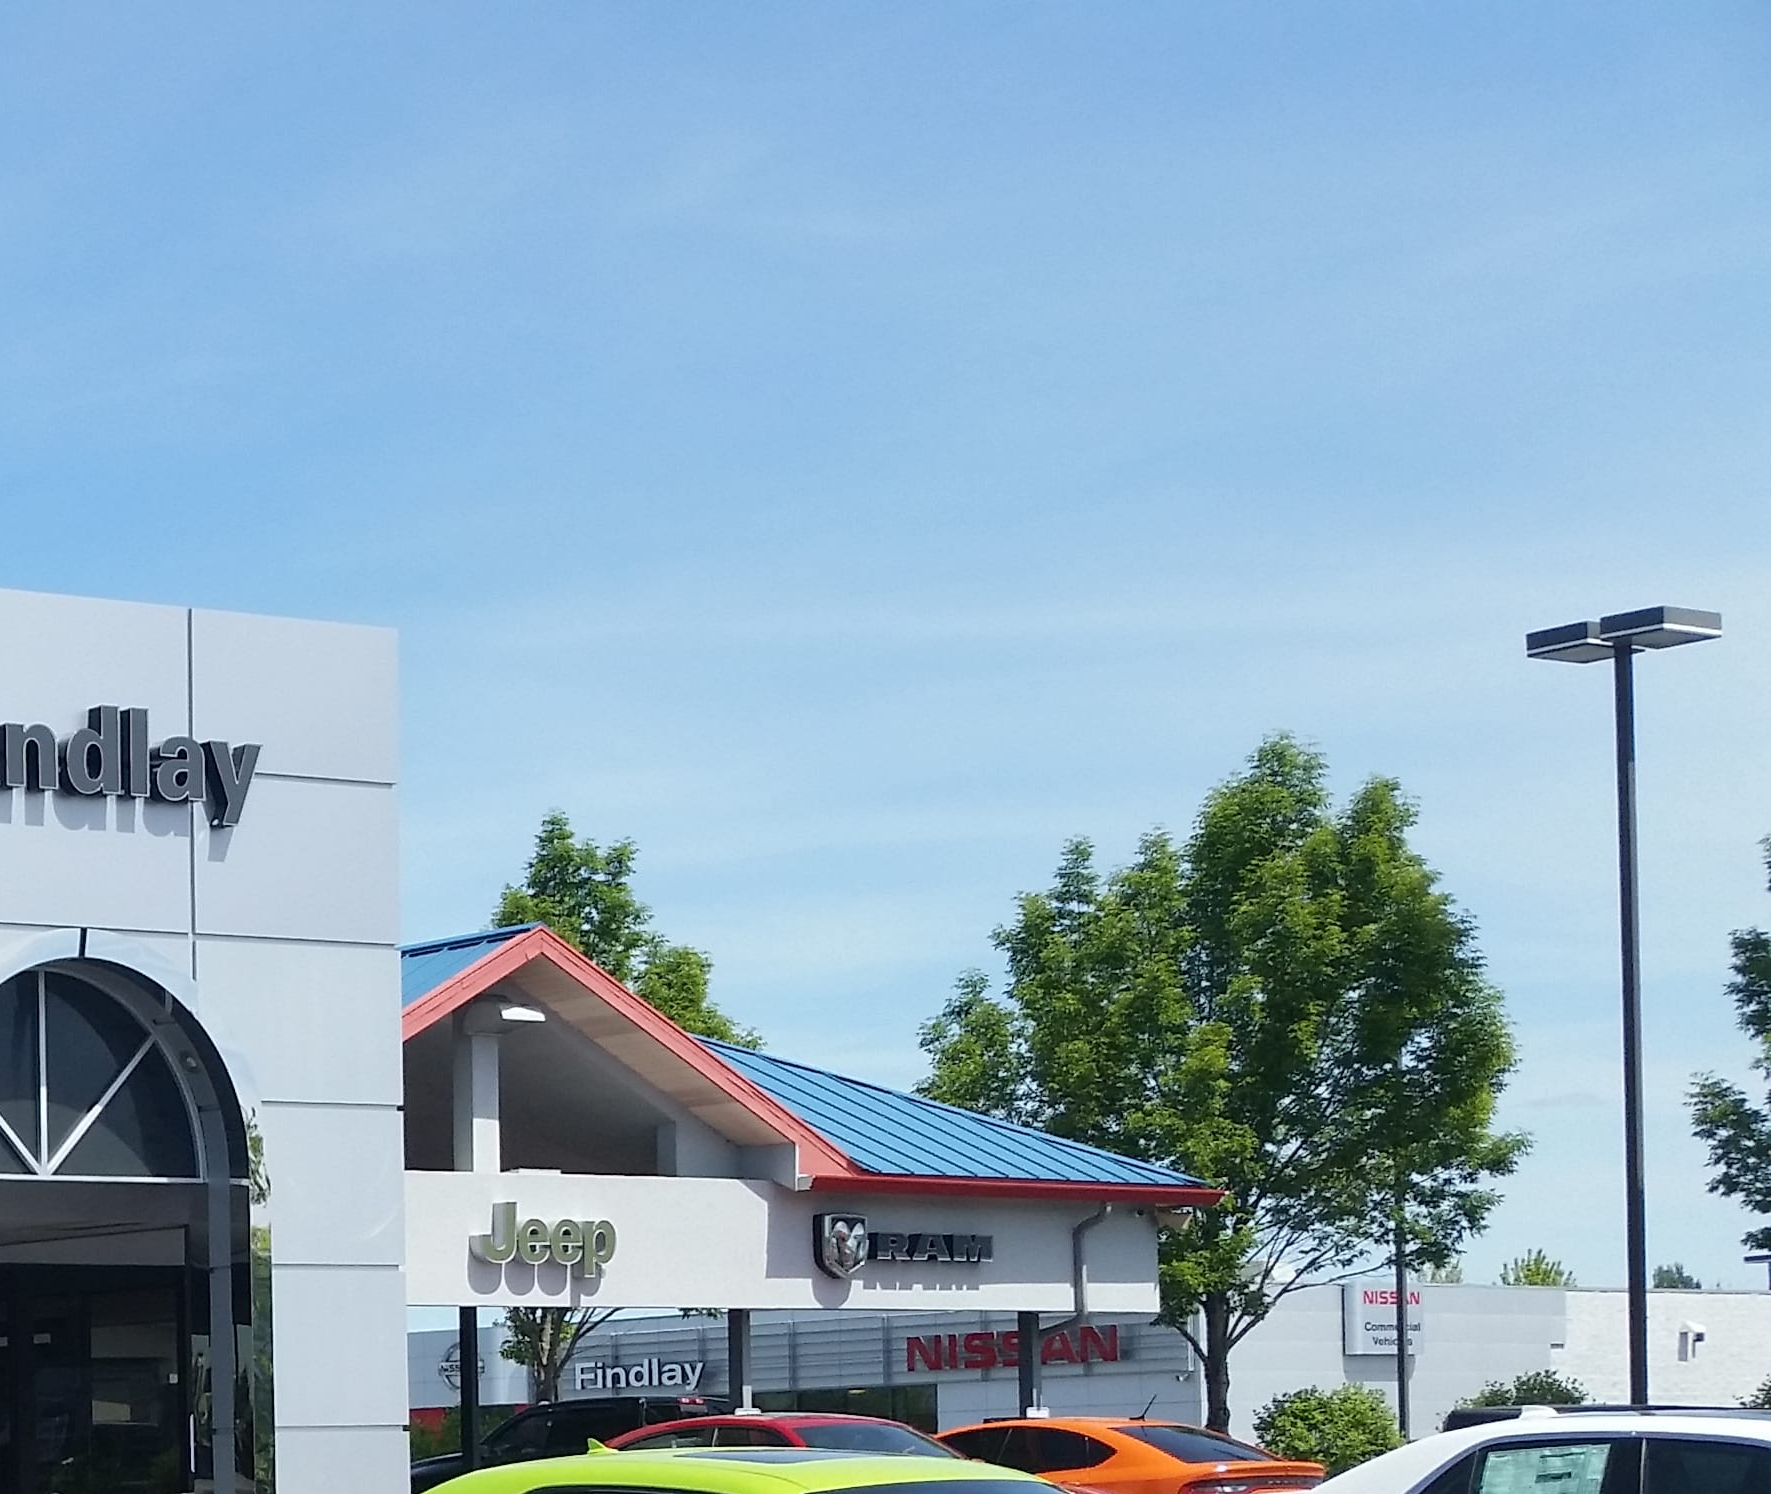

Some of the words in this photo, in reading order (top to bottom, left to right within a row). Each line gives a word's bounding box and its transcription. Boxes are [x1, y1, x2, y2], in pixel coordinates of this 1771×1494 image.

[469, 1201, 617, 1277] Jeep
[868, 1232, 994, 1262] RAM
[1363, 1290, 1420, 1305] NISSN
[574, 1358, 705, 1391] Findlay
